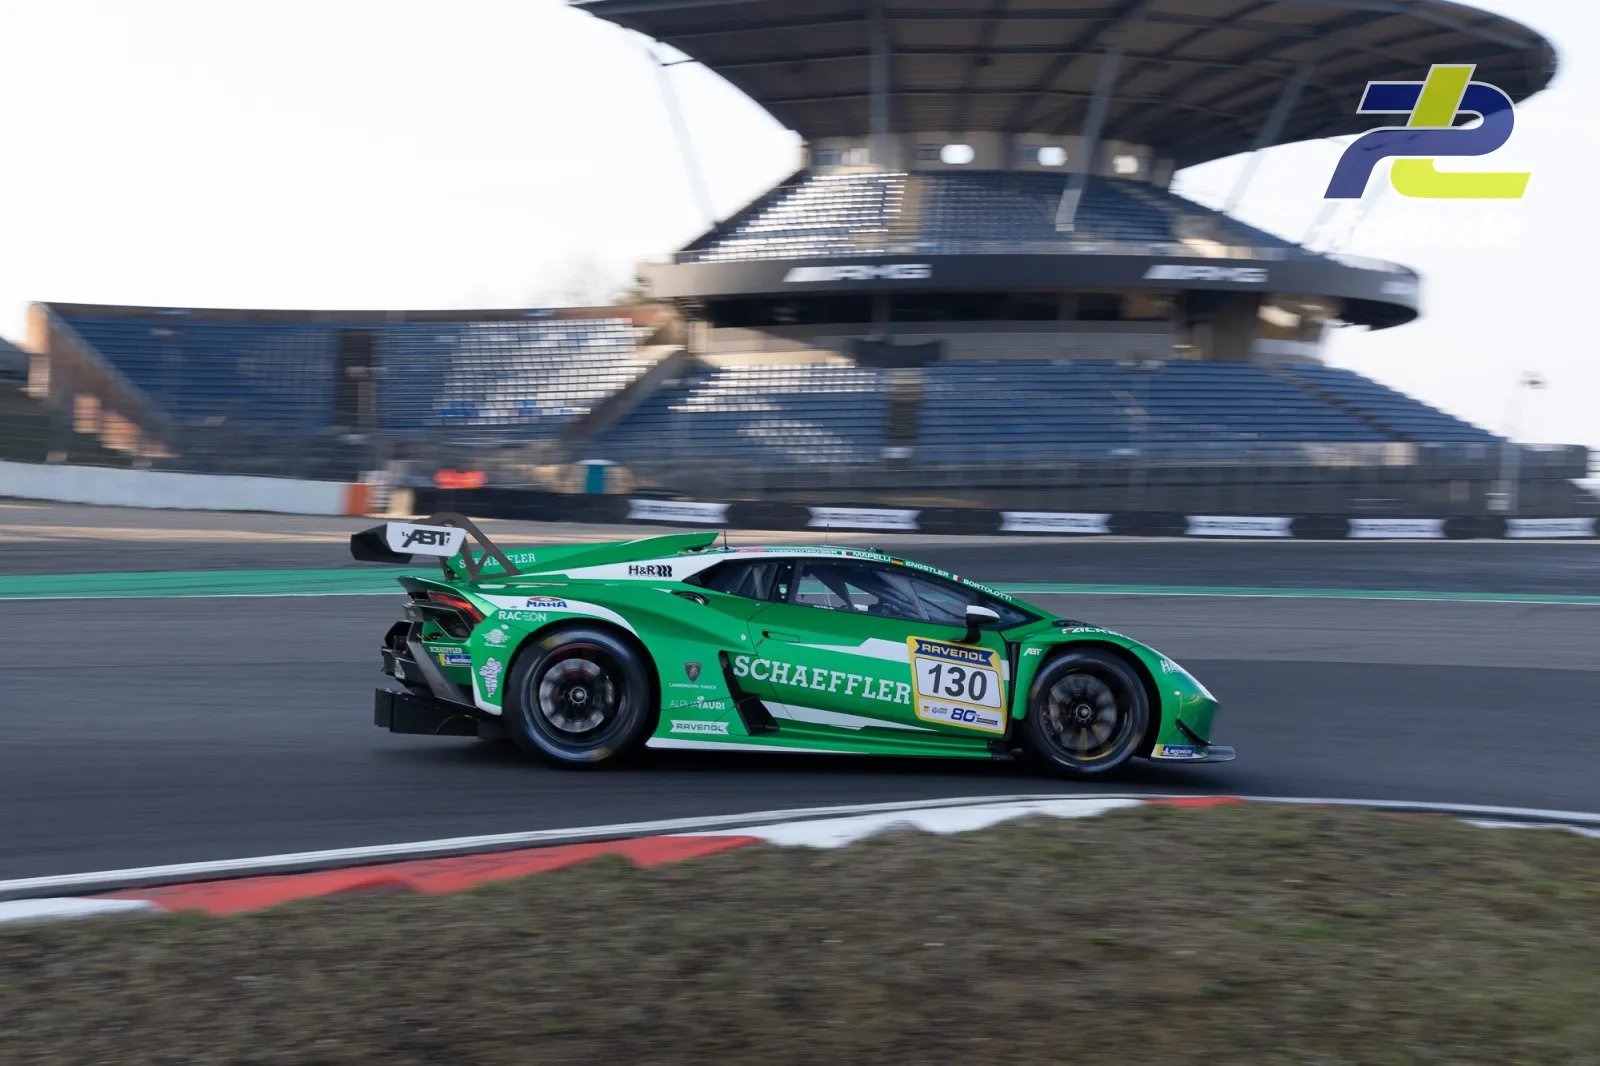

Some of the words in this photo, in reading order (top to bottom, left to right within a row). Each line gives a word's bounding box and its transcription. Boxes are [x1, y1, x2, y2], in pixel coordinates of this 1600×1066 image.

[401, 529, 450, 548] ABT
[852, 552, 891, 563] MAPELLI
[628, 565, 659, 577] H&R
[905, 561, 949, 578] ENGSTLER
[963, 579, 1012, 602] BORTOLOTTI
[526, 600, 568, 609] MAHA
[922, 644, 987, 662] RAVENOL
[1023, 647, 1042, 657] ABT
[733, 655, 912, 705] SCHAEFFLER
[928, 663, 987, 701] 130
[676, 723, 724, 732] RAVENOL
